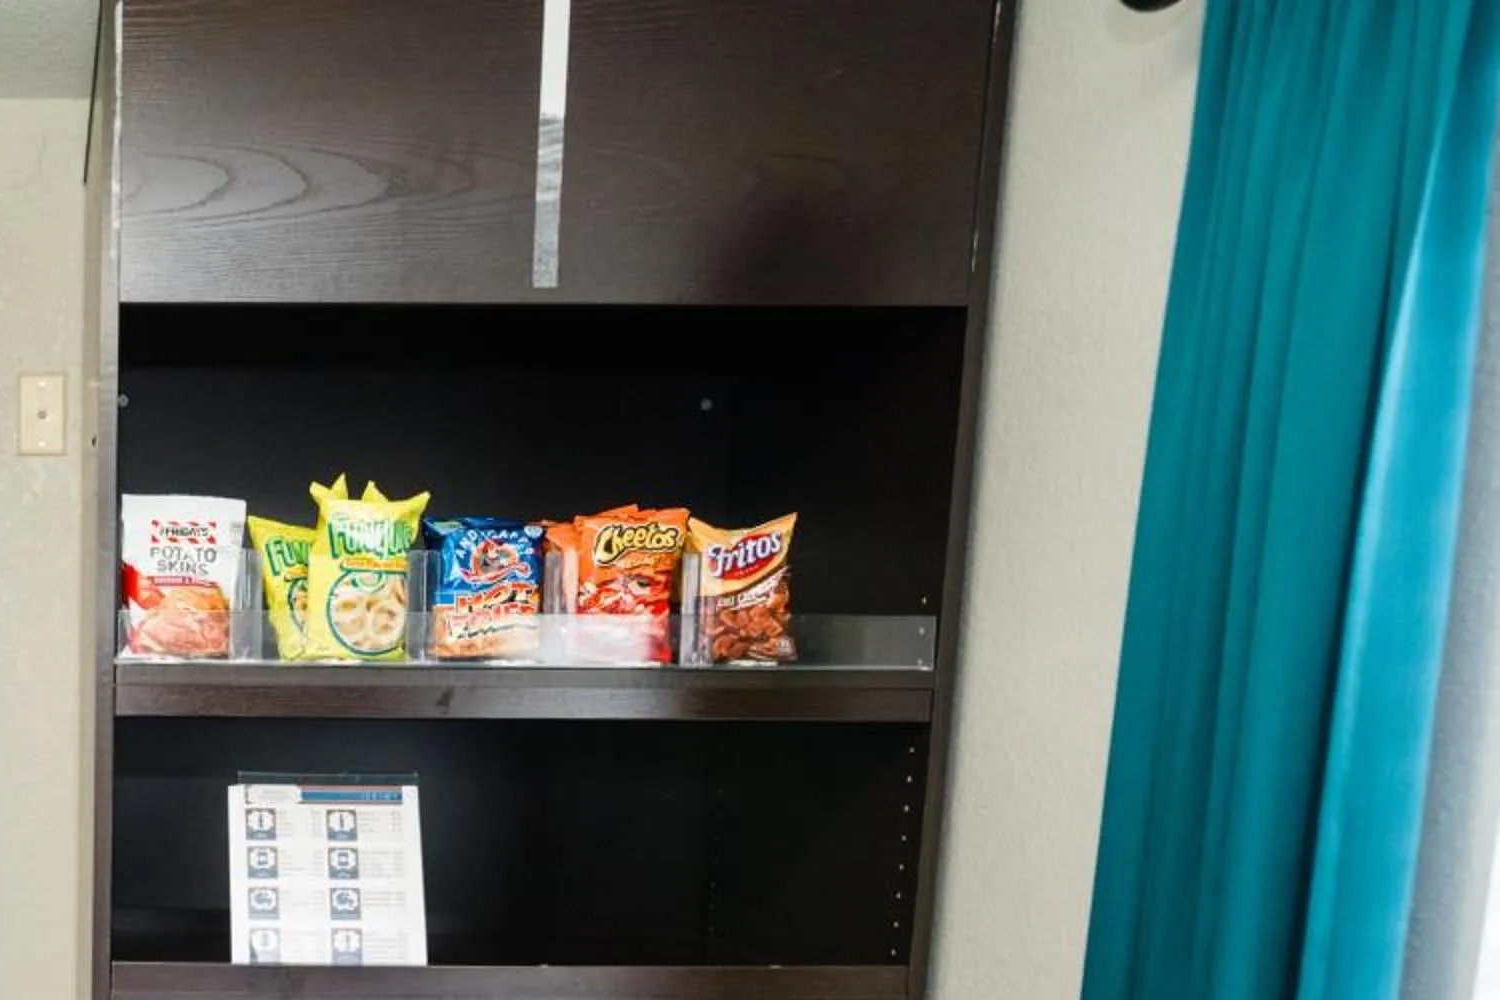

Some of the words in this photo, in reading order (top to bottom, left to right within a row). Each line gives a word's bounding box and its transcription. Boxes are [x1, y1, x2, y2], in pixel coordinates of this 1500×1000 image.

[150, 546, 217, 564] POTATO
[593, 522, 680, 566] Cheetos
[706, 531, 784, 578] Fritos
[157, 559, 209, 576] SKINS
